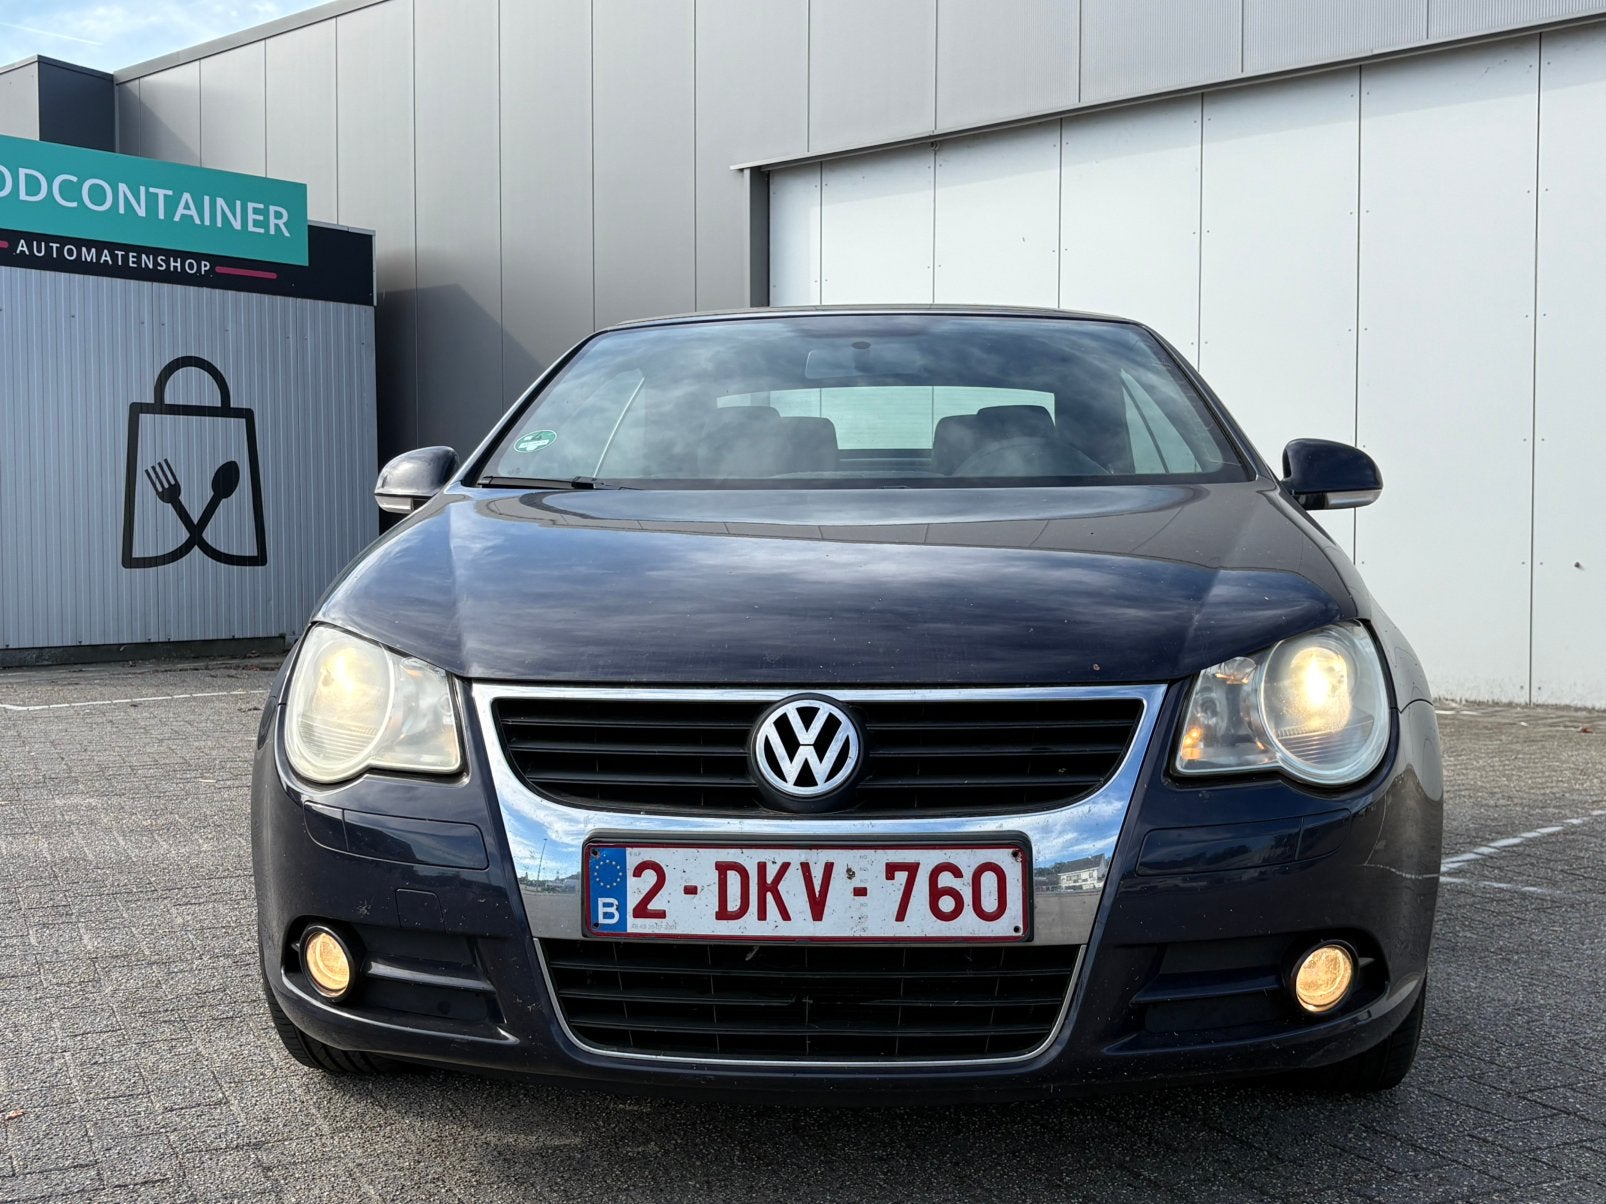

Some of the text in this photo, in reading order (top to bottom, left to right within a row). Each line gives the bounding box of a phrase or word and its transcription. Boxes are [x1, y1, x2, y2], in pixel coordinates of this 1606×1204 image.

[16, 239, 211, 275] AUTOMATENSHOP
[758, 702, 857, 793] VW
[598, 897, 620, 925] B
